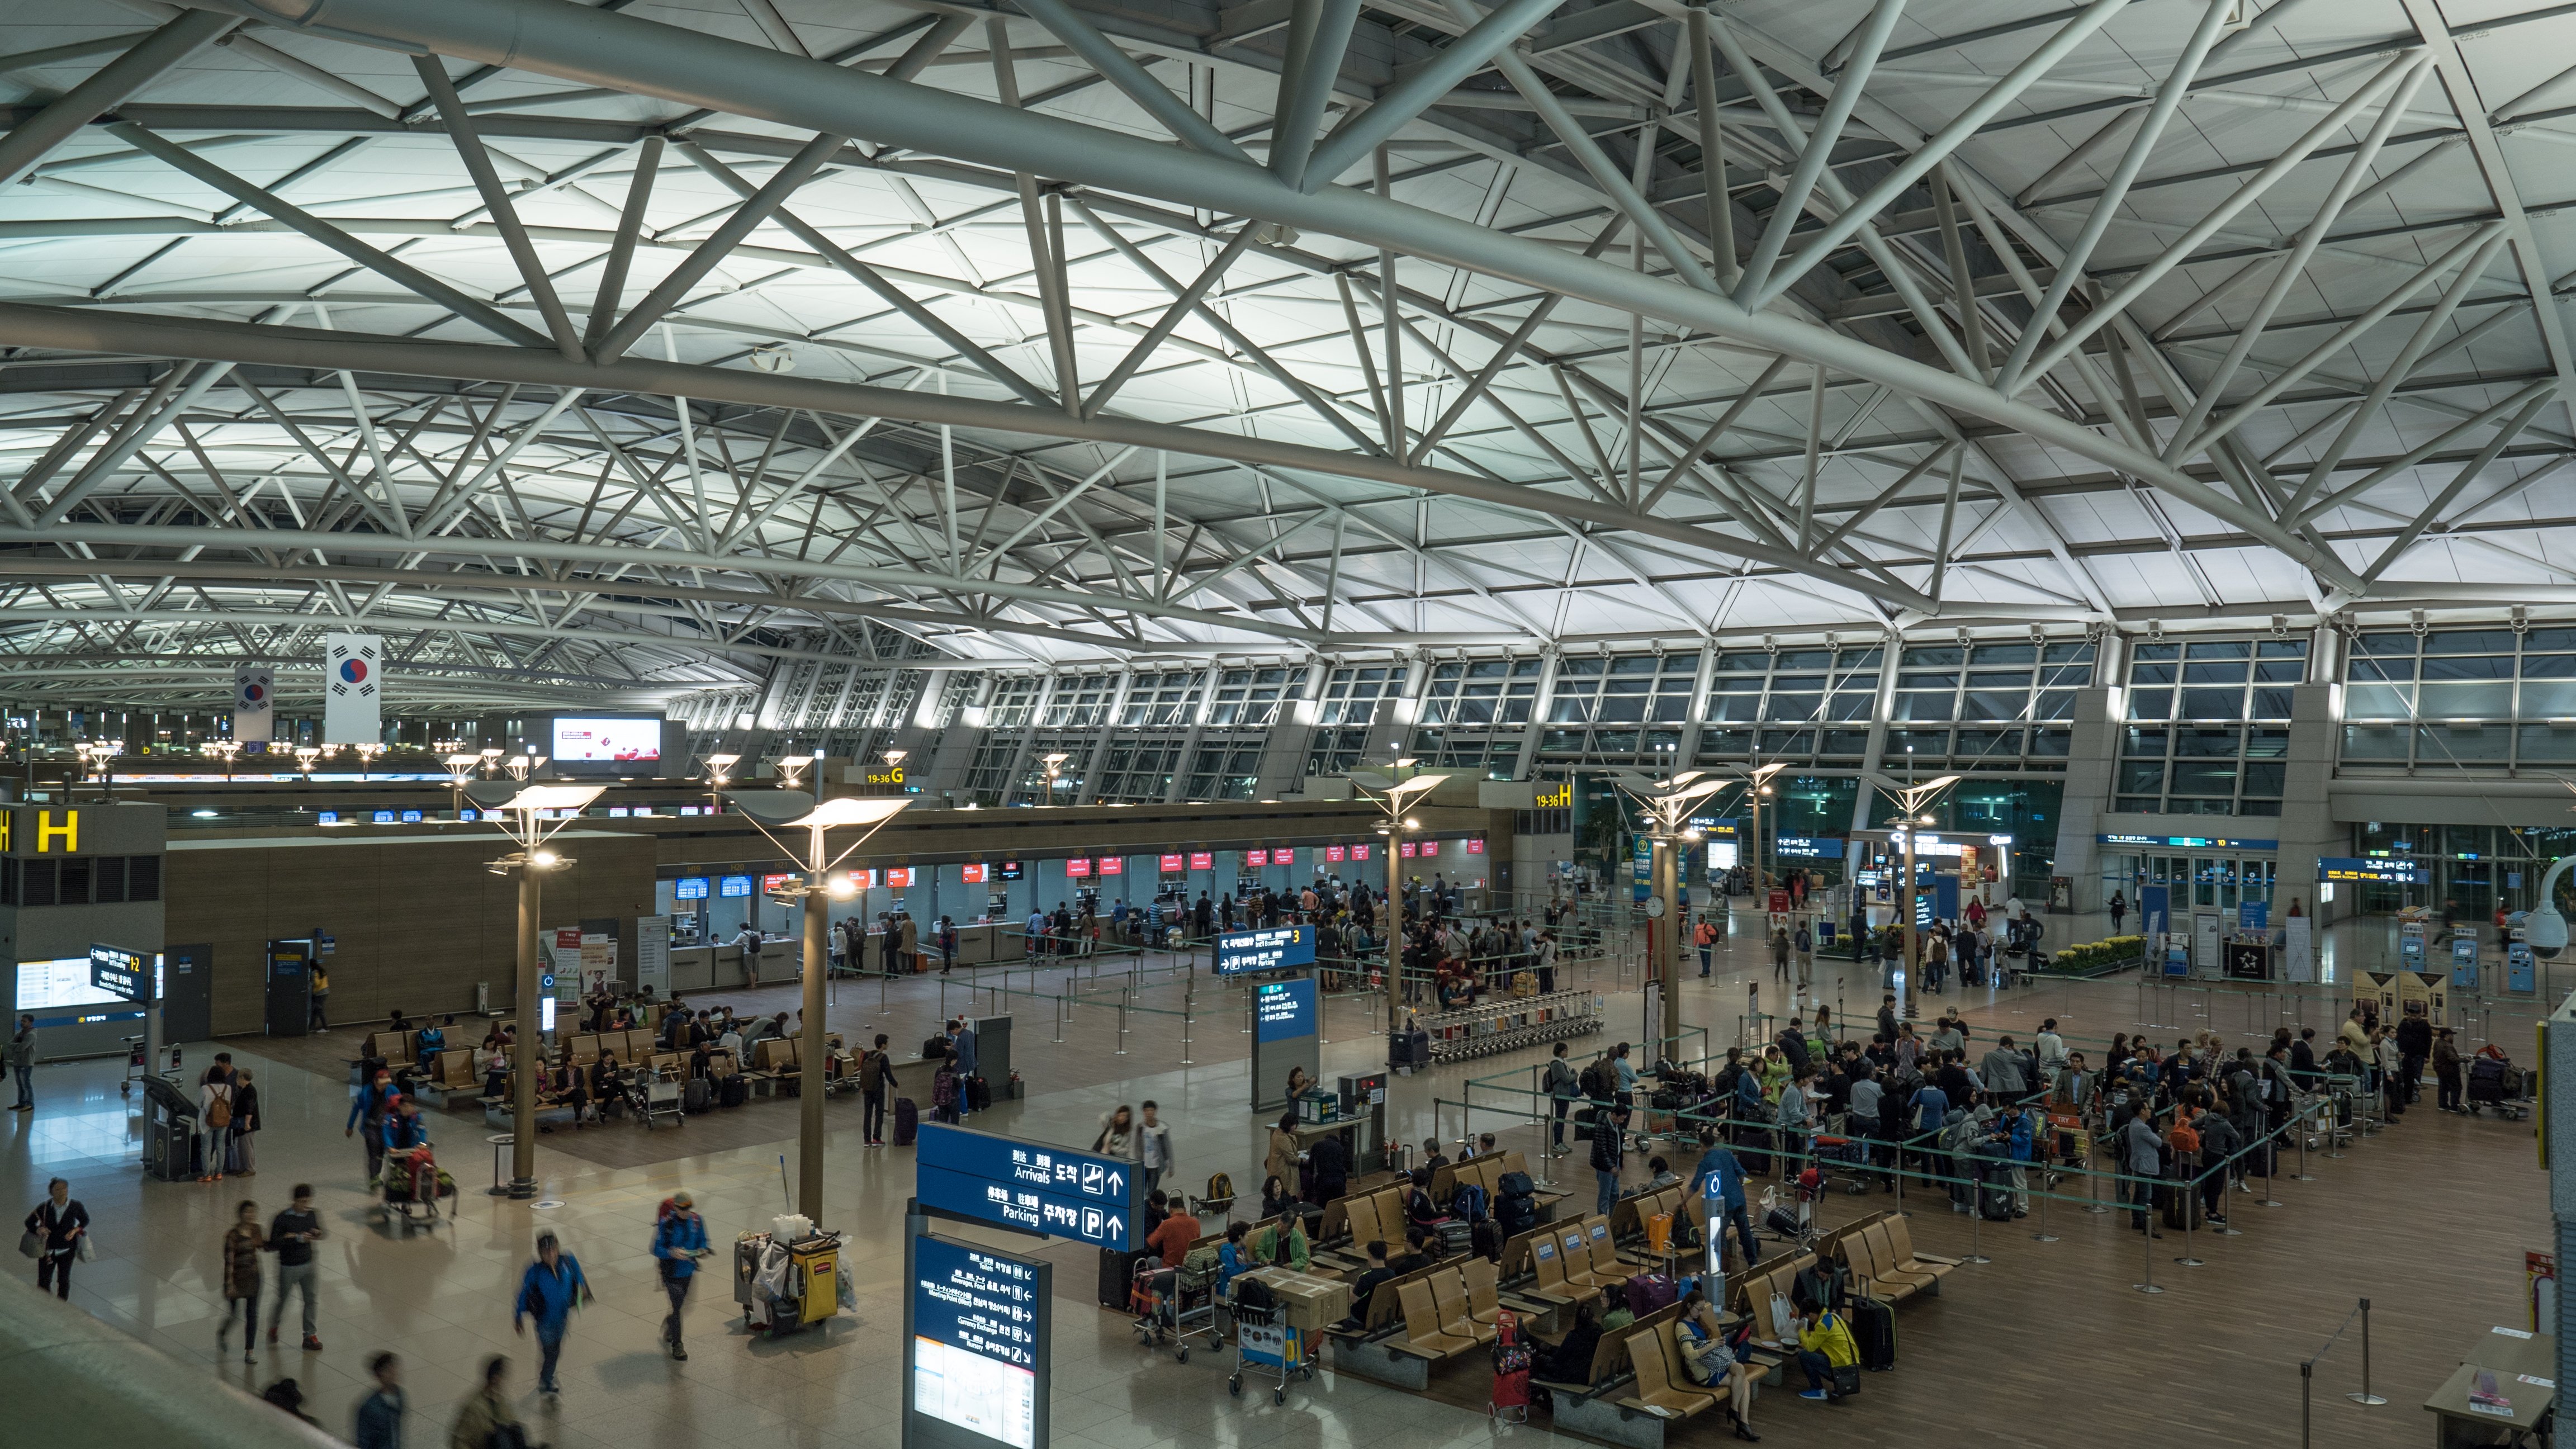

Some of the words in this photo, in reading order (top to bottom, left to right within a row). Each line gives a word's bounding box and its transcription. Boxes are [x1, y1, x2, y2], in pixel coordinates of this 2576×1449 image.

[891, 768, 903, 783] G
[1536, 795, 1558, 807] 19-36
[1560, 784, 1571, 806] H
[38, 811, 78, 852] H
[1926, 863, 1930, 872] 3
[1293, 930, 1300, 943] 3
[130, 956, 140, 972] 1-2
[1012, 1149, 1026, 1163] 到达
[1036, 1154, 1051, 1168] 到着
[1015, 1166, 1050, 1184] Arrivals
[1055, 1163, 1078, 1183] 도착
[987, 1186, 1008, 1201] 停车场
[1003, 1205, 1039, 1227] Parking
[1043, 1204, 1077, 1227] 주차장
[979, 1262, 994, 1272] Toilets
[995, 1262, 1011, 1275] 화장실
[951, 1277, 974, 1288] Beverages,
[974, 1282, 986, 1291] Food
[1000, 1284, 1011, 1295] 식사
[929, 1289, 946, 1301] Meeting
[946, 1294, 958, 1304] Point
[958, 1298, 972, 1308] (West)
[957, 1317, 977, 1329] Currency
[977, 1323, 998, 1336] Exchange
[966, 1340, 983, 1352] Nursery
